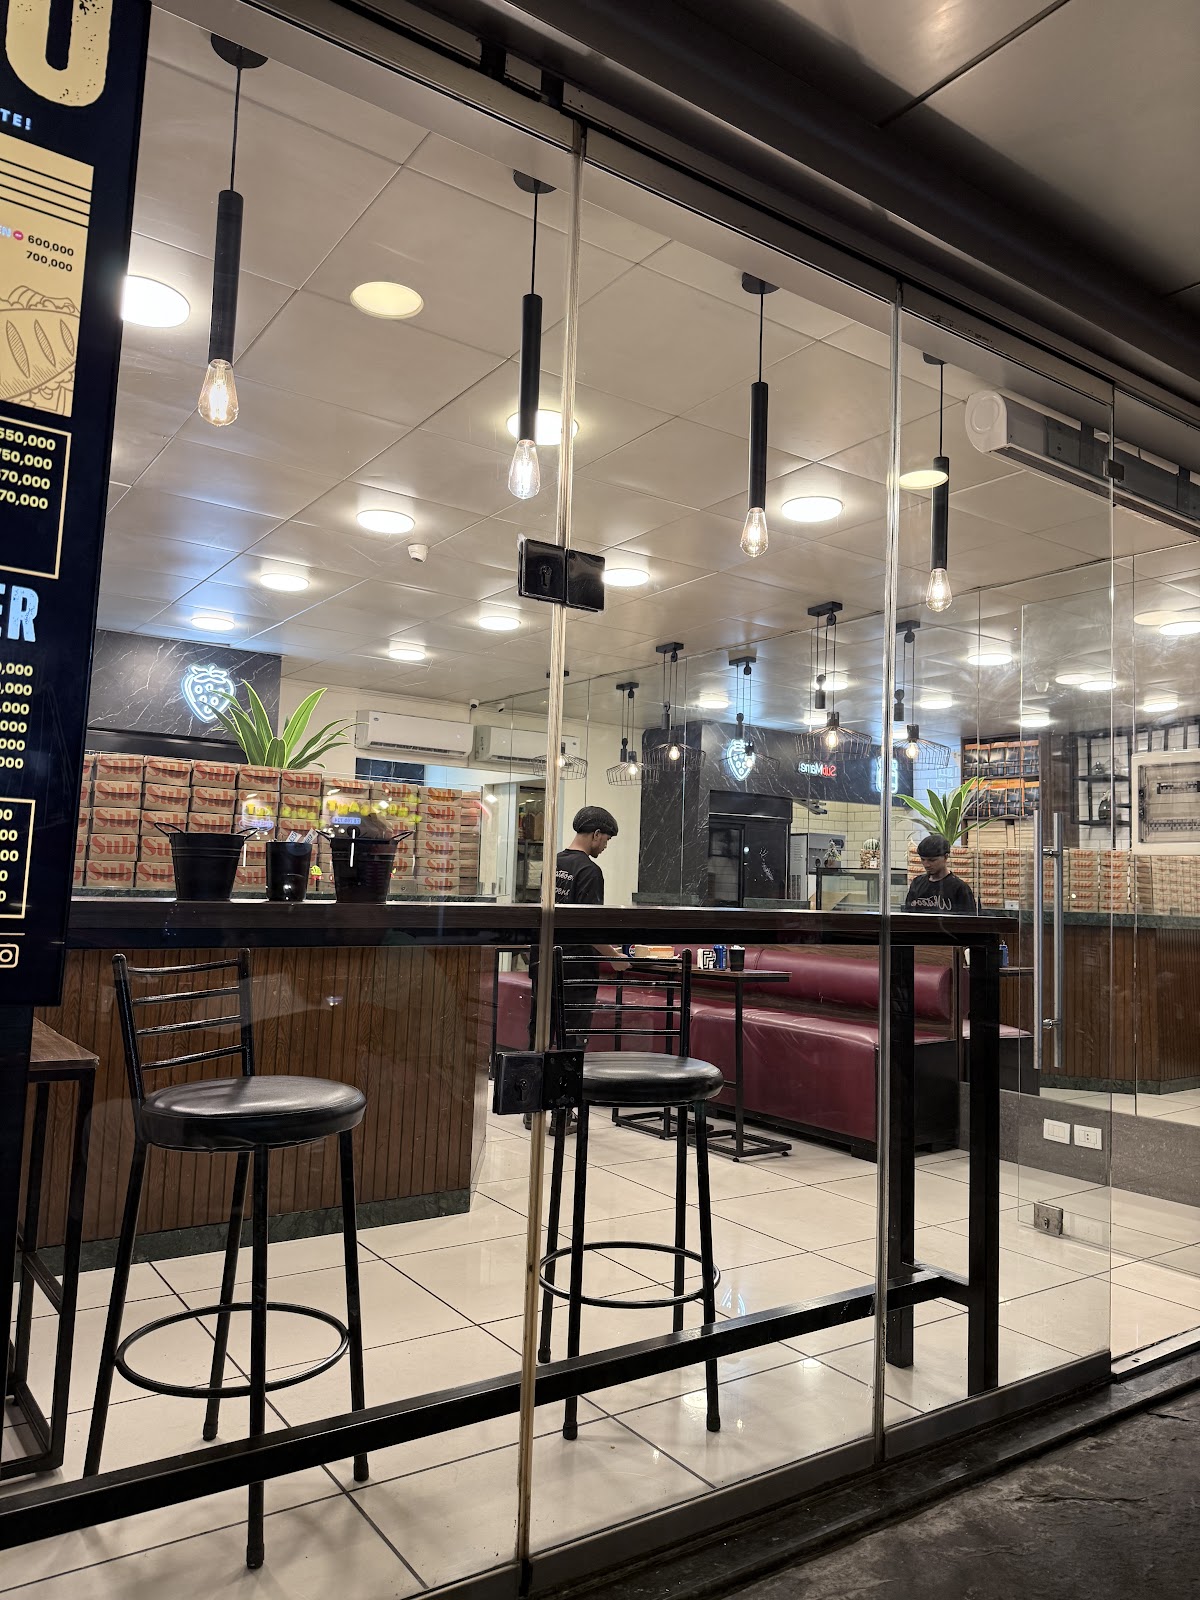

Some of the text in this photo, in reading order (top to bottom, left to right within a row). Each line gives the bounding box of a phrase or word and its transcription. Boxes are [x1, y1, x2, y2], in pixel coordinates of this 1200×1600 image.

[27, 234, 74, 257] 600,000
[26, 250, 73, 272] 700,000
[0, 447, 53, 470] 50,000
[0, 468, 51, 490] 70,000
[0, 583, 39, 643] R
[0, 661, 33, 677] ,000
[0, 682, 32, 696] ,000
[98, 755, 142, 775] Sub
[146, 757, 190, 780] Sub
[194, 762, 236, 783] Sub
[241, 766, 280, 786] Sub
[283, 772, 320, 790] Sub
[95, 782, 140, 802] Sub
[146, 785, 188, 806] Sub
[194, 788, 235, 808] Sub
[382, 783, 412, 798] Sub
[427, 787, 456, 802] Sub
[0, 808, 13, 821] 0
[94, 808, 138, 828] Sub
[427, 805, 456, 820] Sub
[190, 814, 231, 833] Sub
[426, 823, 455, 838] Sub
[91, 835, 136, 855] Sub
[425, 841, 454, 856] Sub
[87, 861, 132, 882] Sub
[426, 859, 455, 874] Sub
[424, 877, 454, 892] Sub
